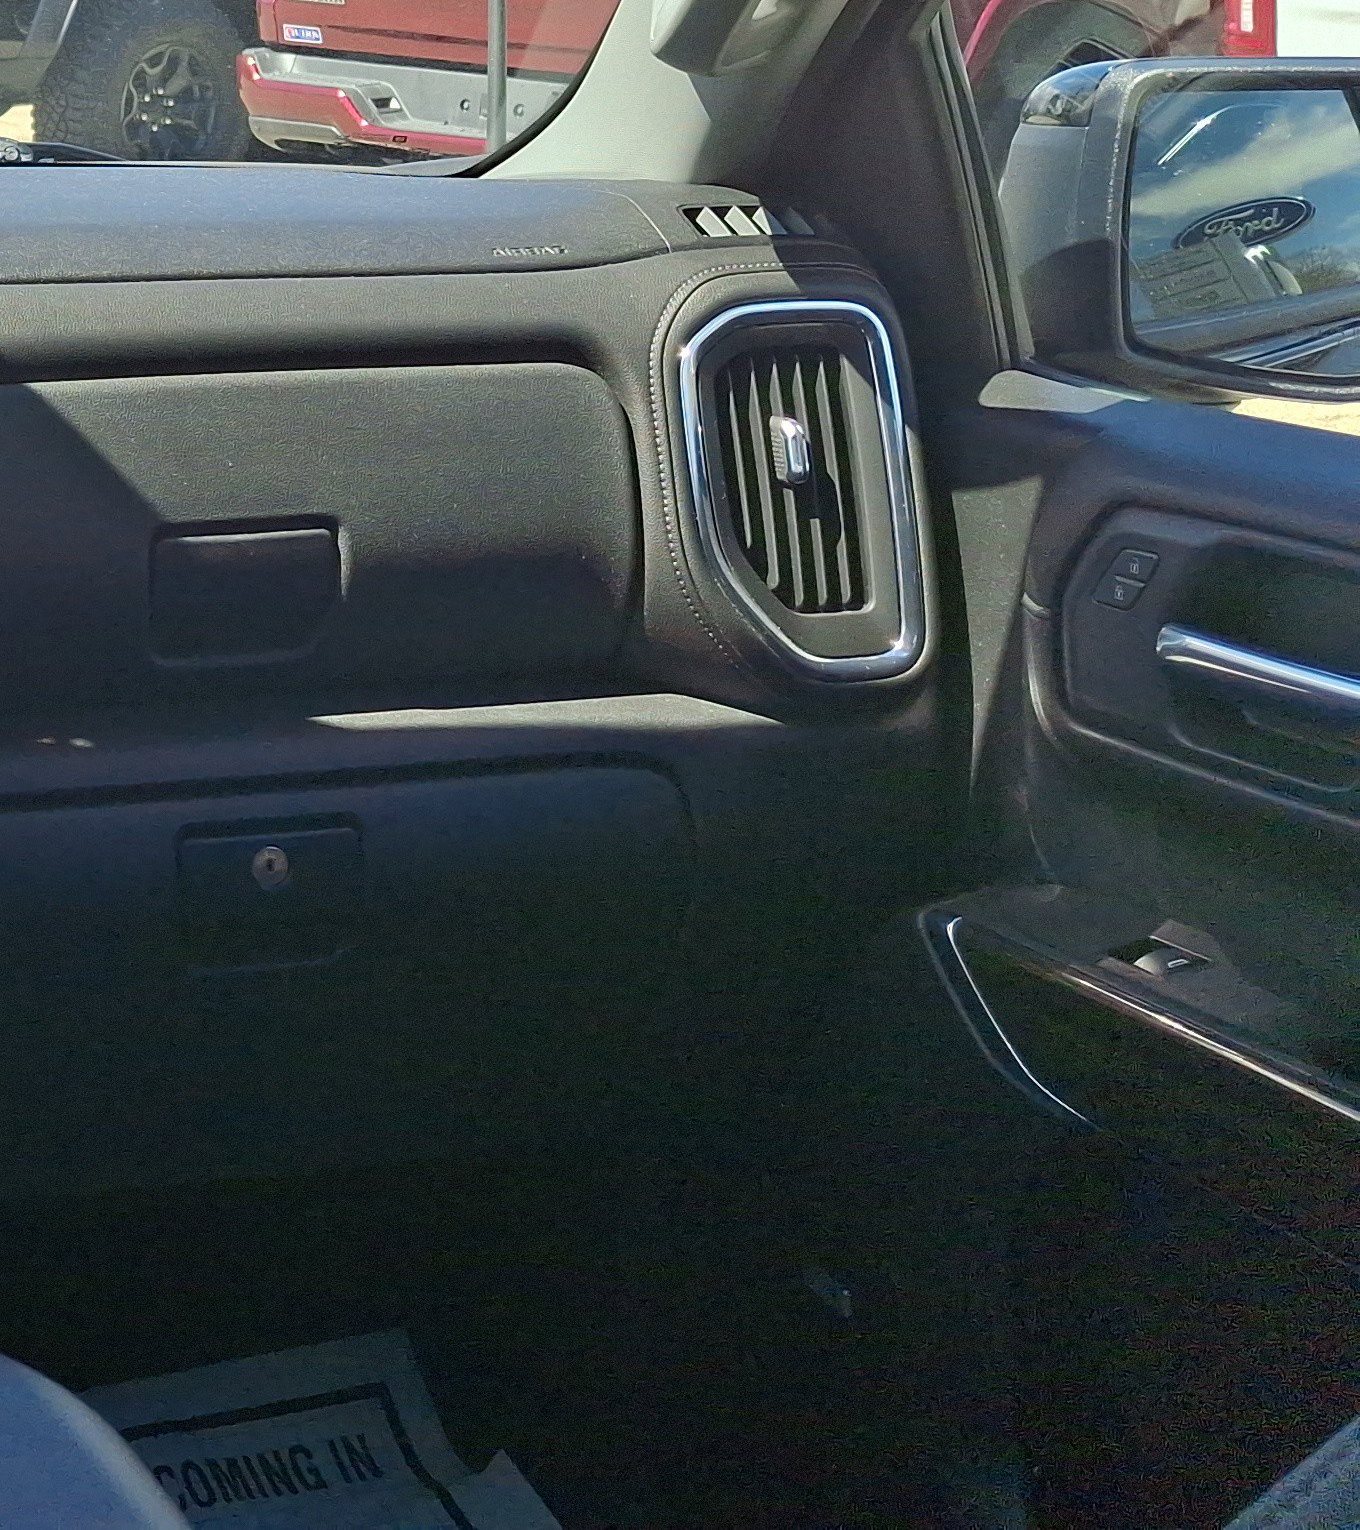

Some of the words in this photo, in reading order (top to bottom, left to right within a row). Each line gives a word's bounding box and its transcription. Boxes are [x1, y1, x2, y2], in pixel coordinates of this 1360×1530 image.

[1203, 207, 1284, 238] Ford
[152, 1443, 329, 1512] COMING
[328, 1433, 385, 1484] IN
